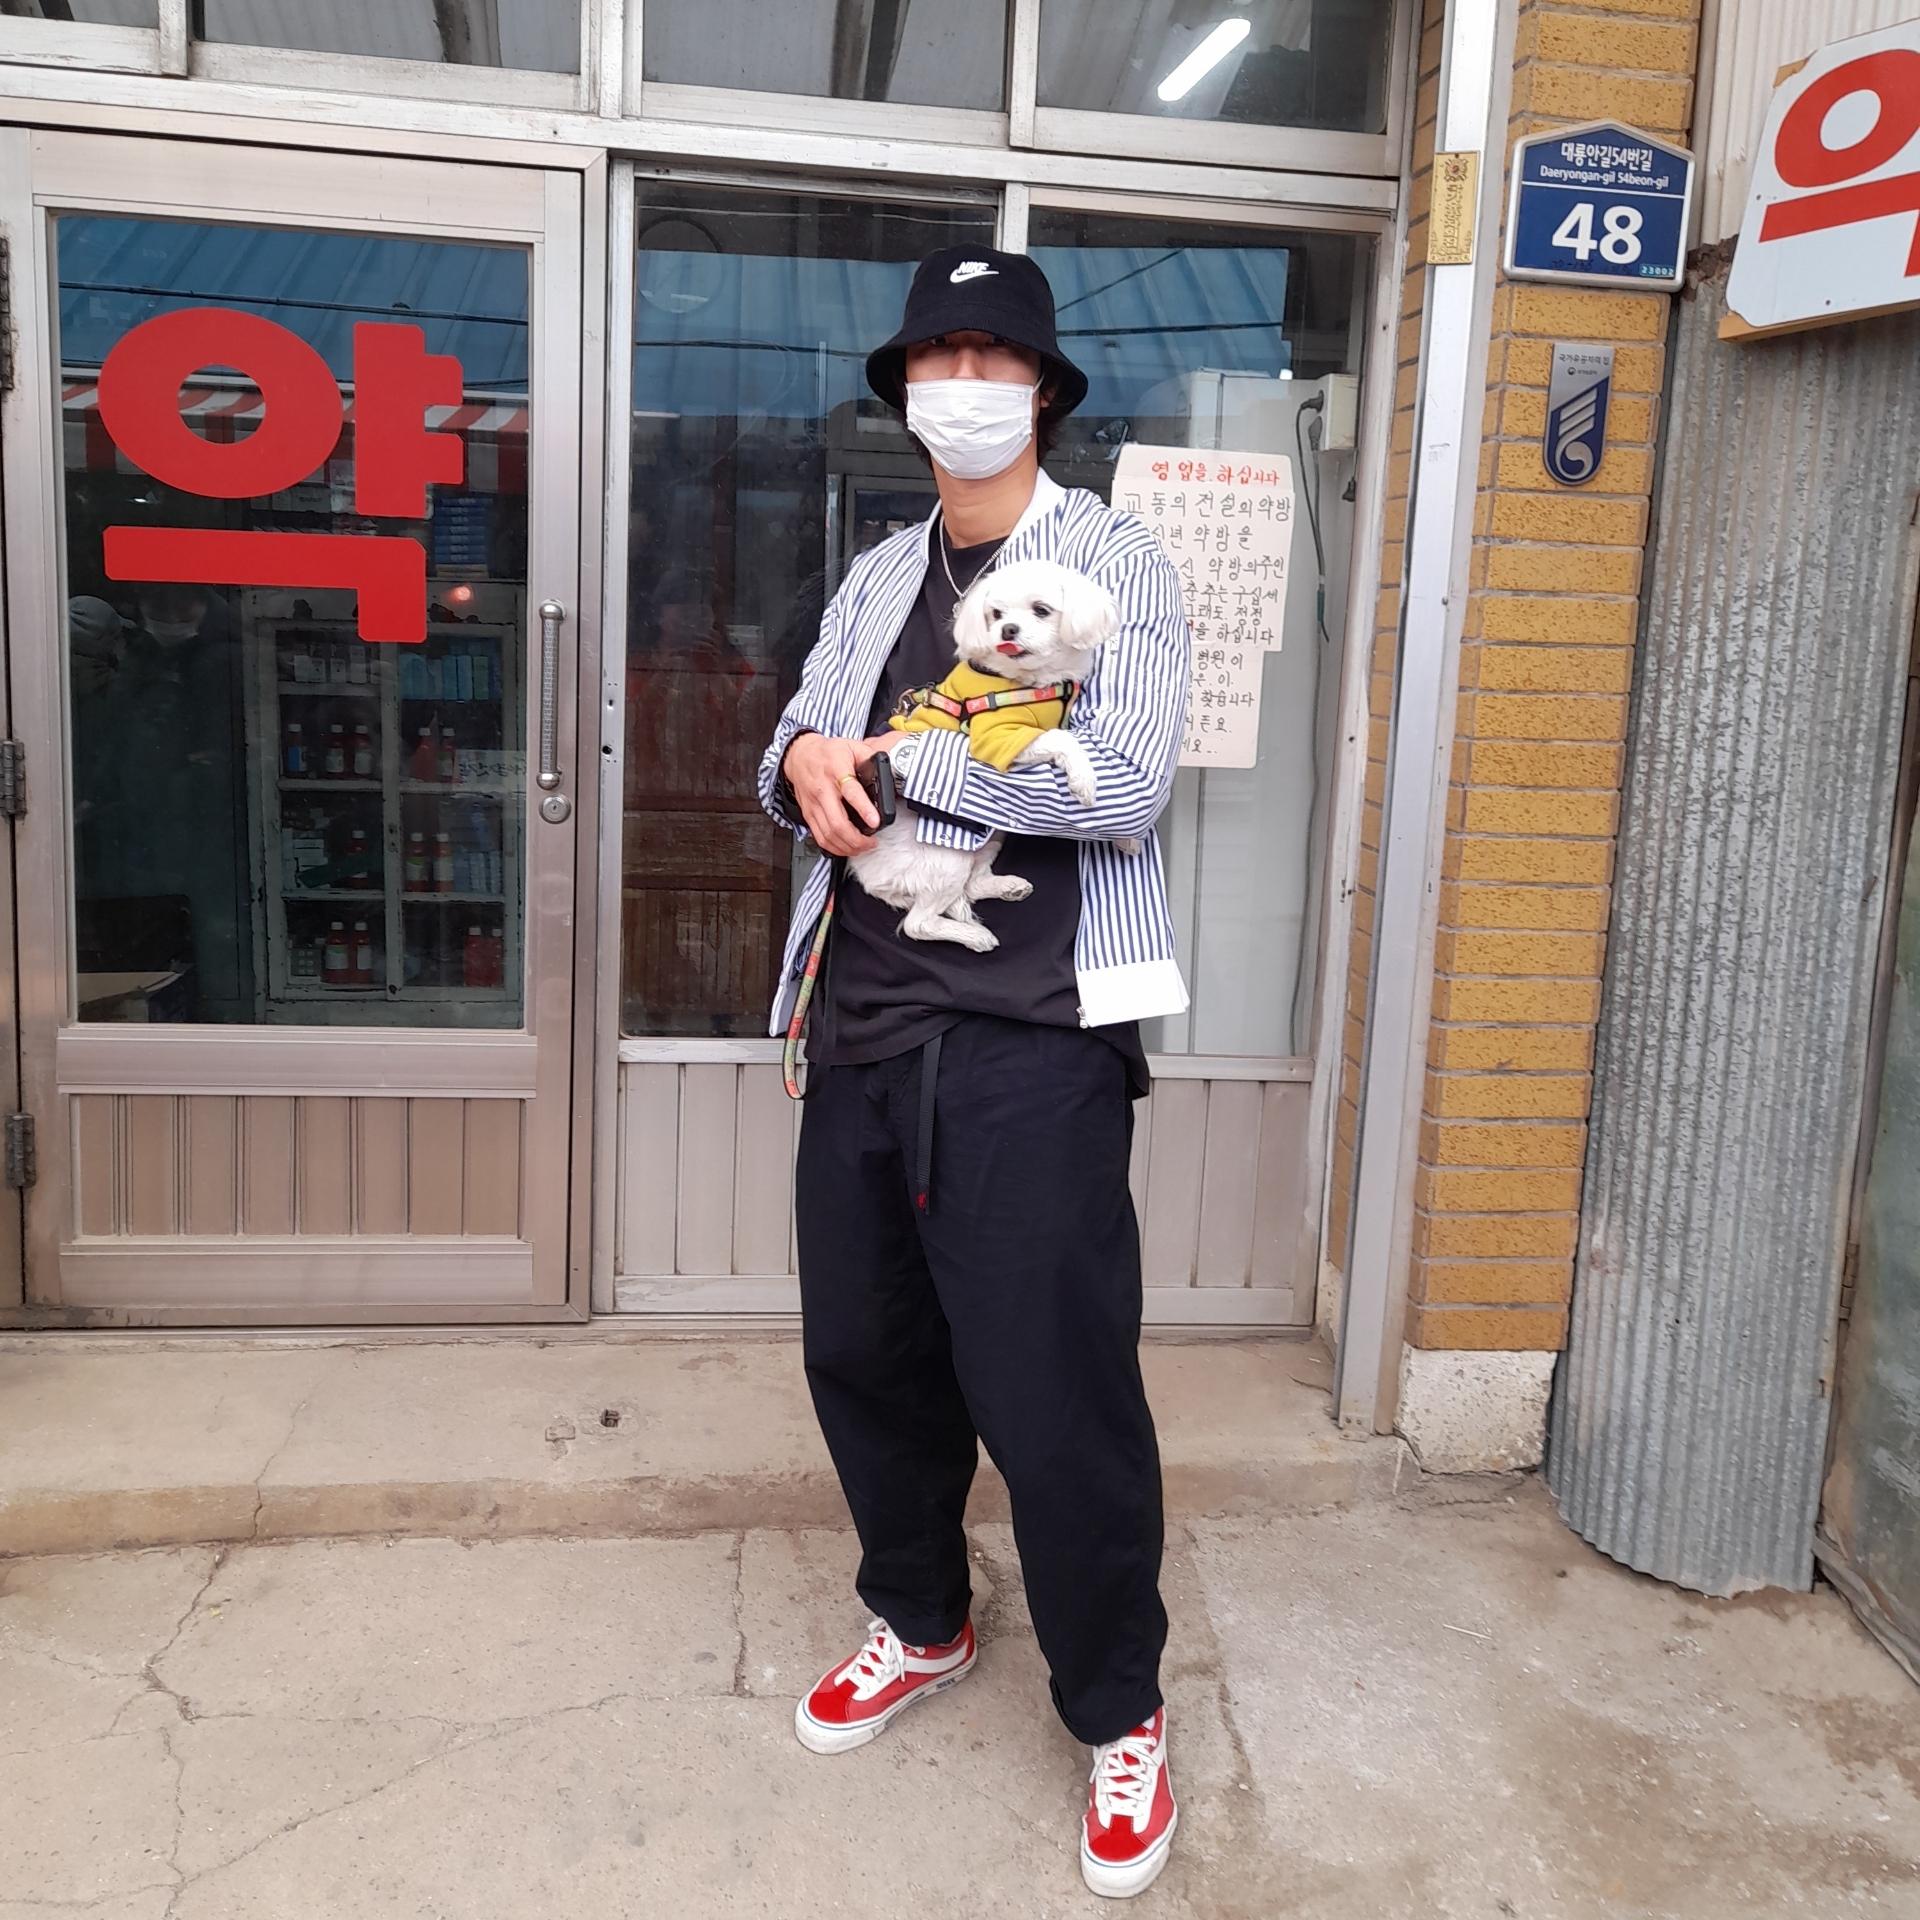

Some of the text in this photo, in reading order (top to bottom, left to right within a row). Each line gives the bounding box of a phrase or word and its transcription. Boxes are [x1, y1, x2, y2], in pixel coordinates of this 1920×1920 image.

[1561, 142, 1653, 172] 대룡안길54번길
[1540, 165, 1669, 190] Daeryongan-gil 54beon-gil
[1551, 202, 1643, 264] 48
[957, 261, 990, 274] NIKE
[1641, 265, 1674, 276] 23002
[97, 307, 464, 643] 약
[1124, 491, 1186, 517] 교동의
